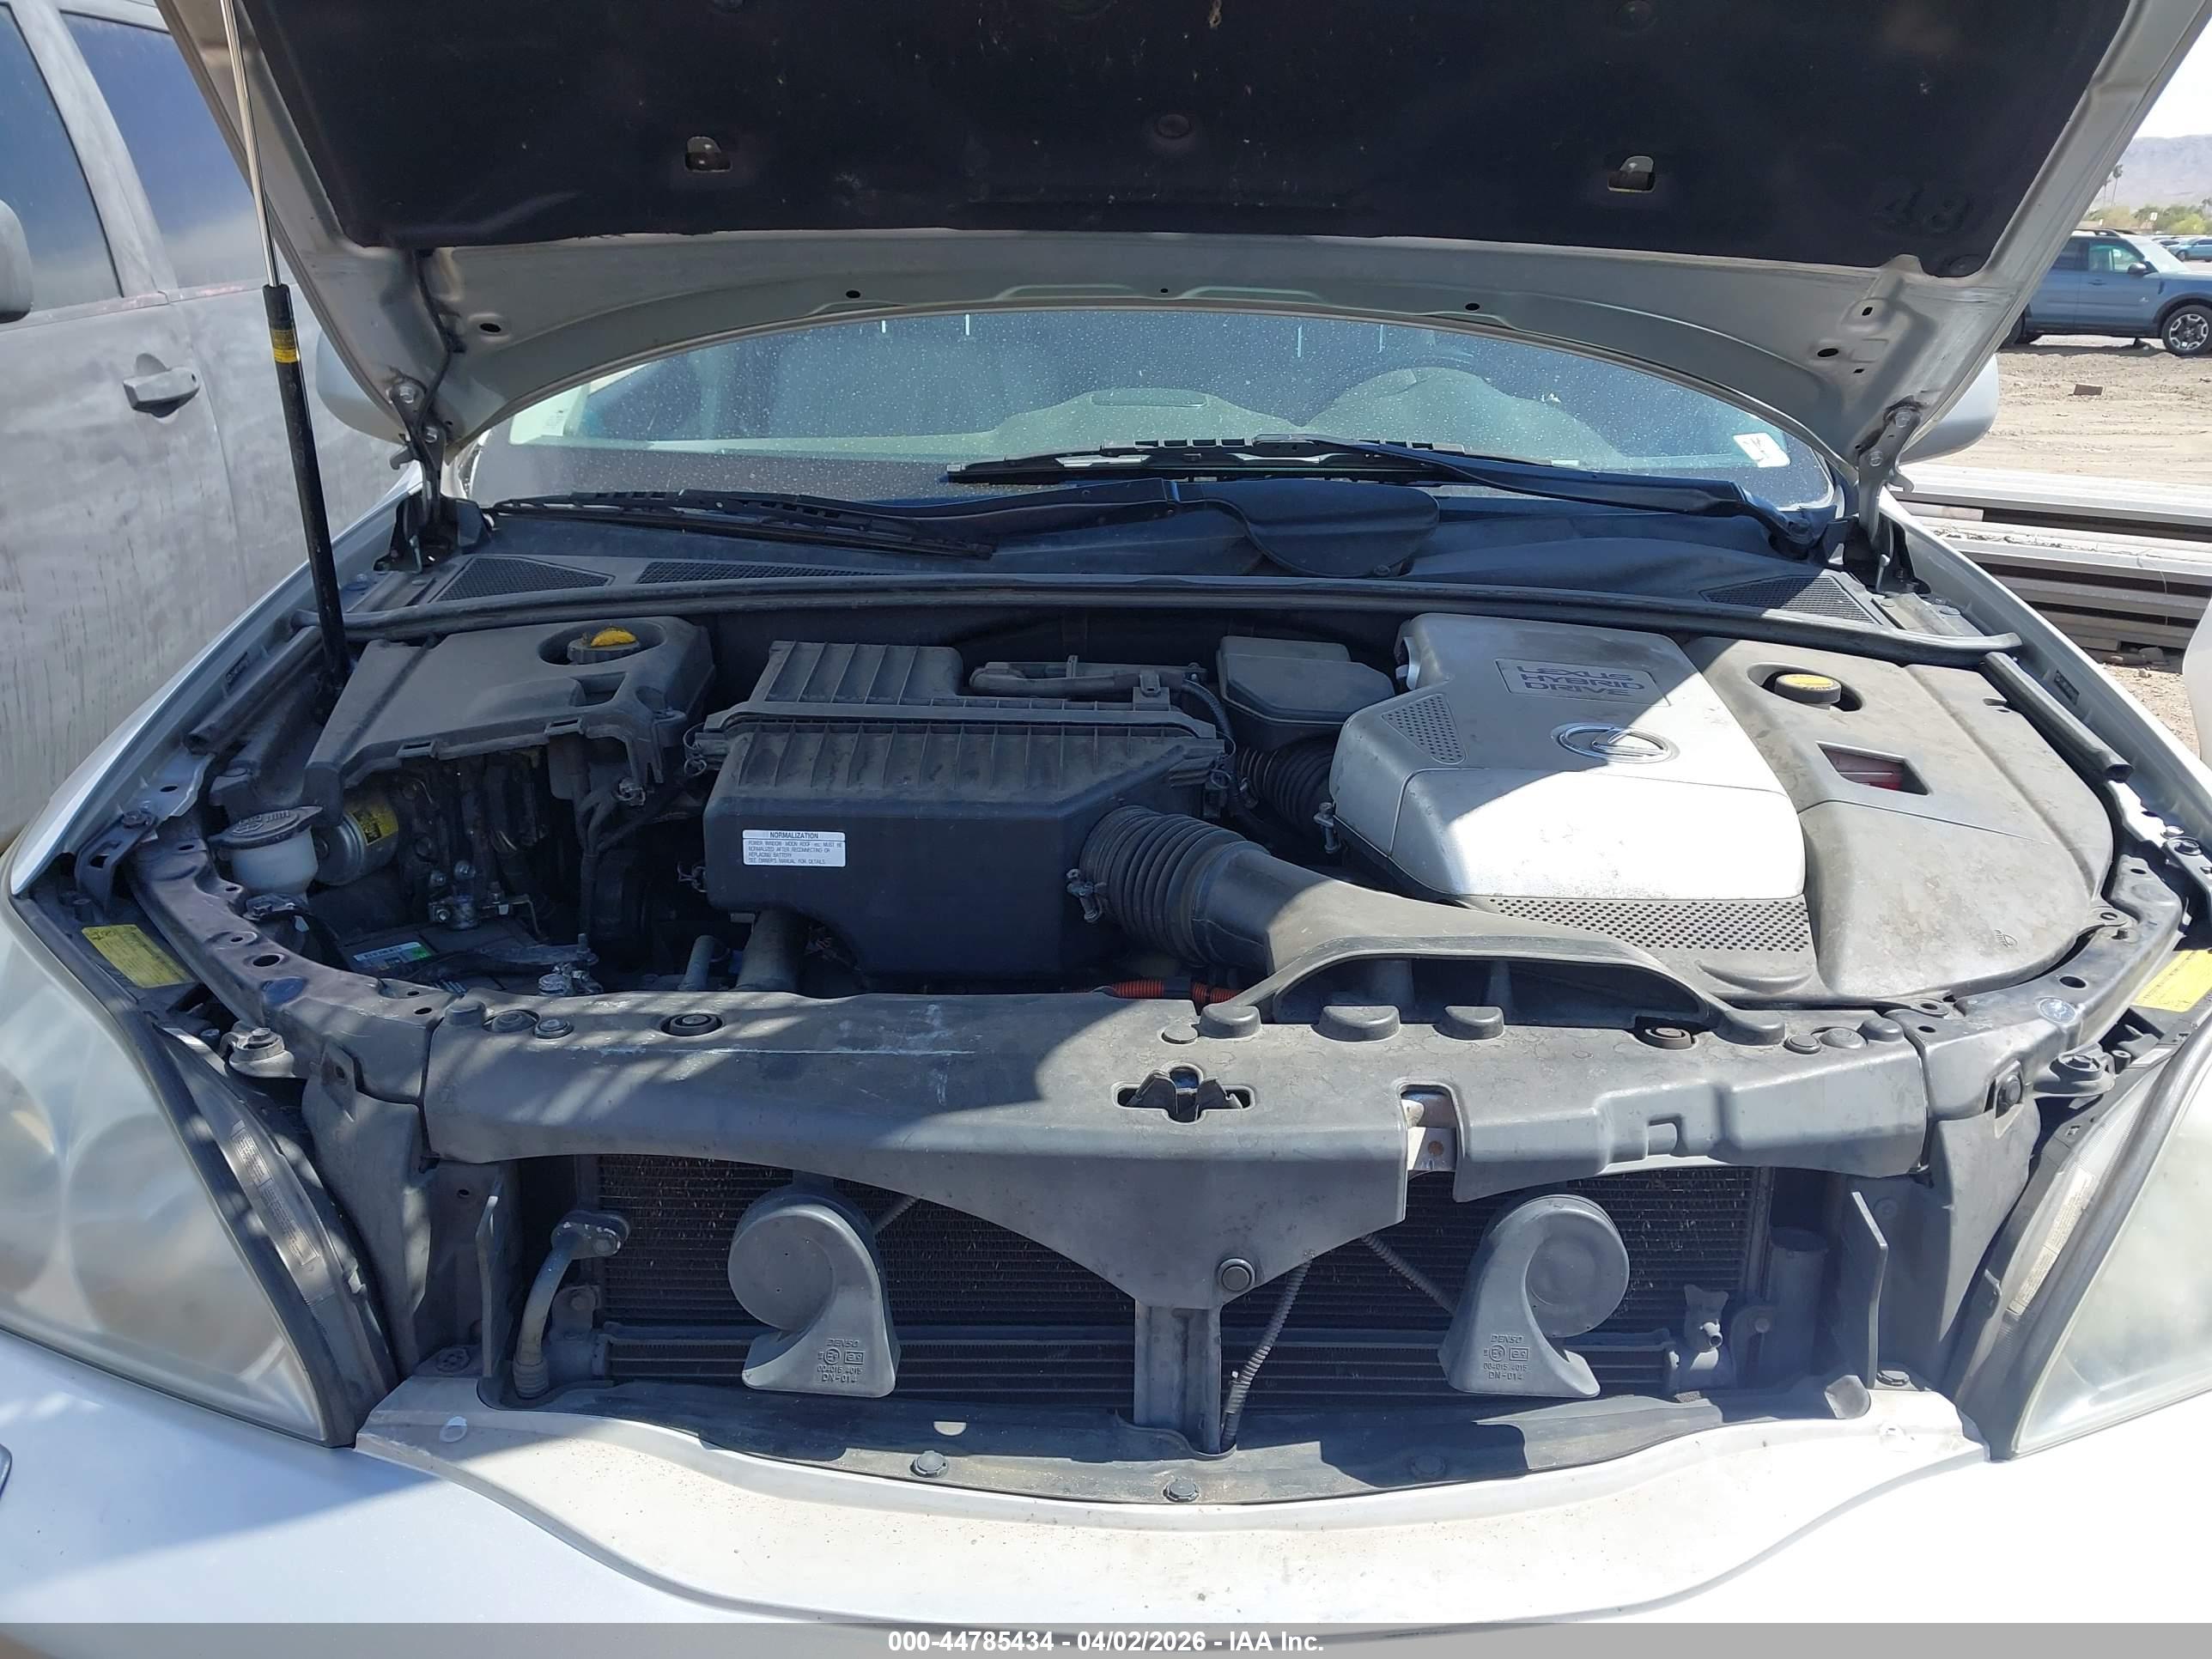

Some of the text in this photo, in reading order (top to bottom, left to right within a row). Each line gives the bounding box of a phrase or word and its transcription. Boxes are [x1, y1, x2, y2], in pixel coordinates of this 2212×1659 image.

[1516, 665, 1634, 681] LEXUS
[1520, 673, 1645, 690] HYBRID
[1524, 682, 1632, 696] DRIVE
[769, 831, 819, 840] NORMALIZATION
[827, 1338, 860, 1347] DENSO
[1491, 1334, 1523, 1343] DENSO
